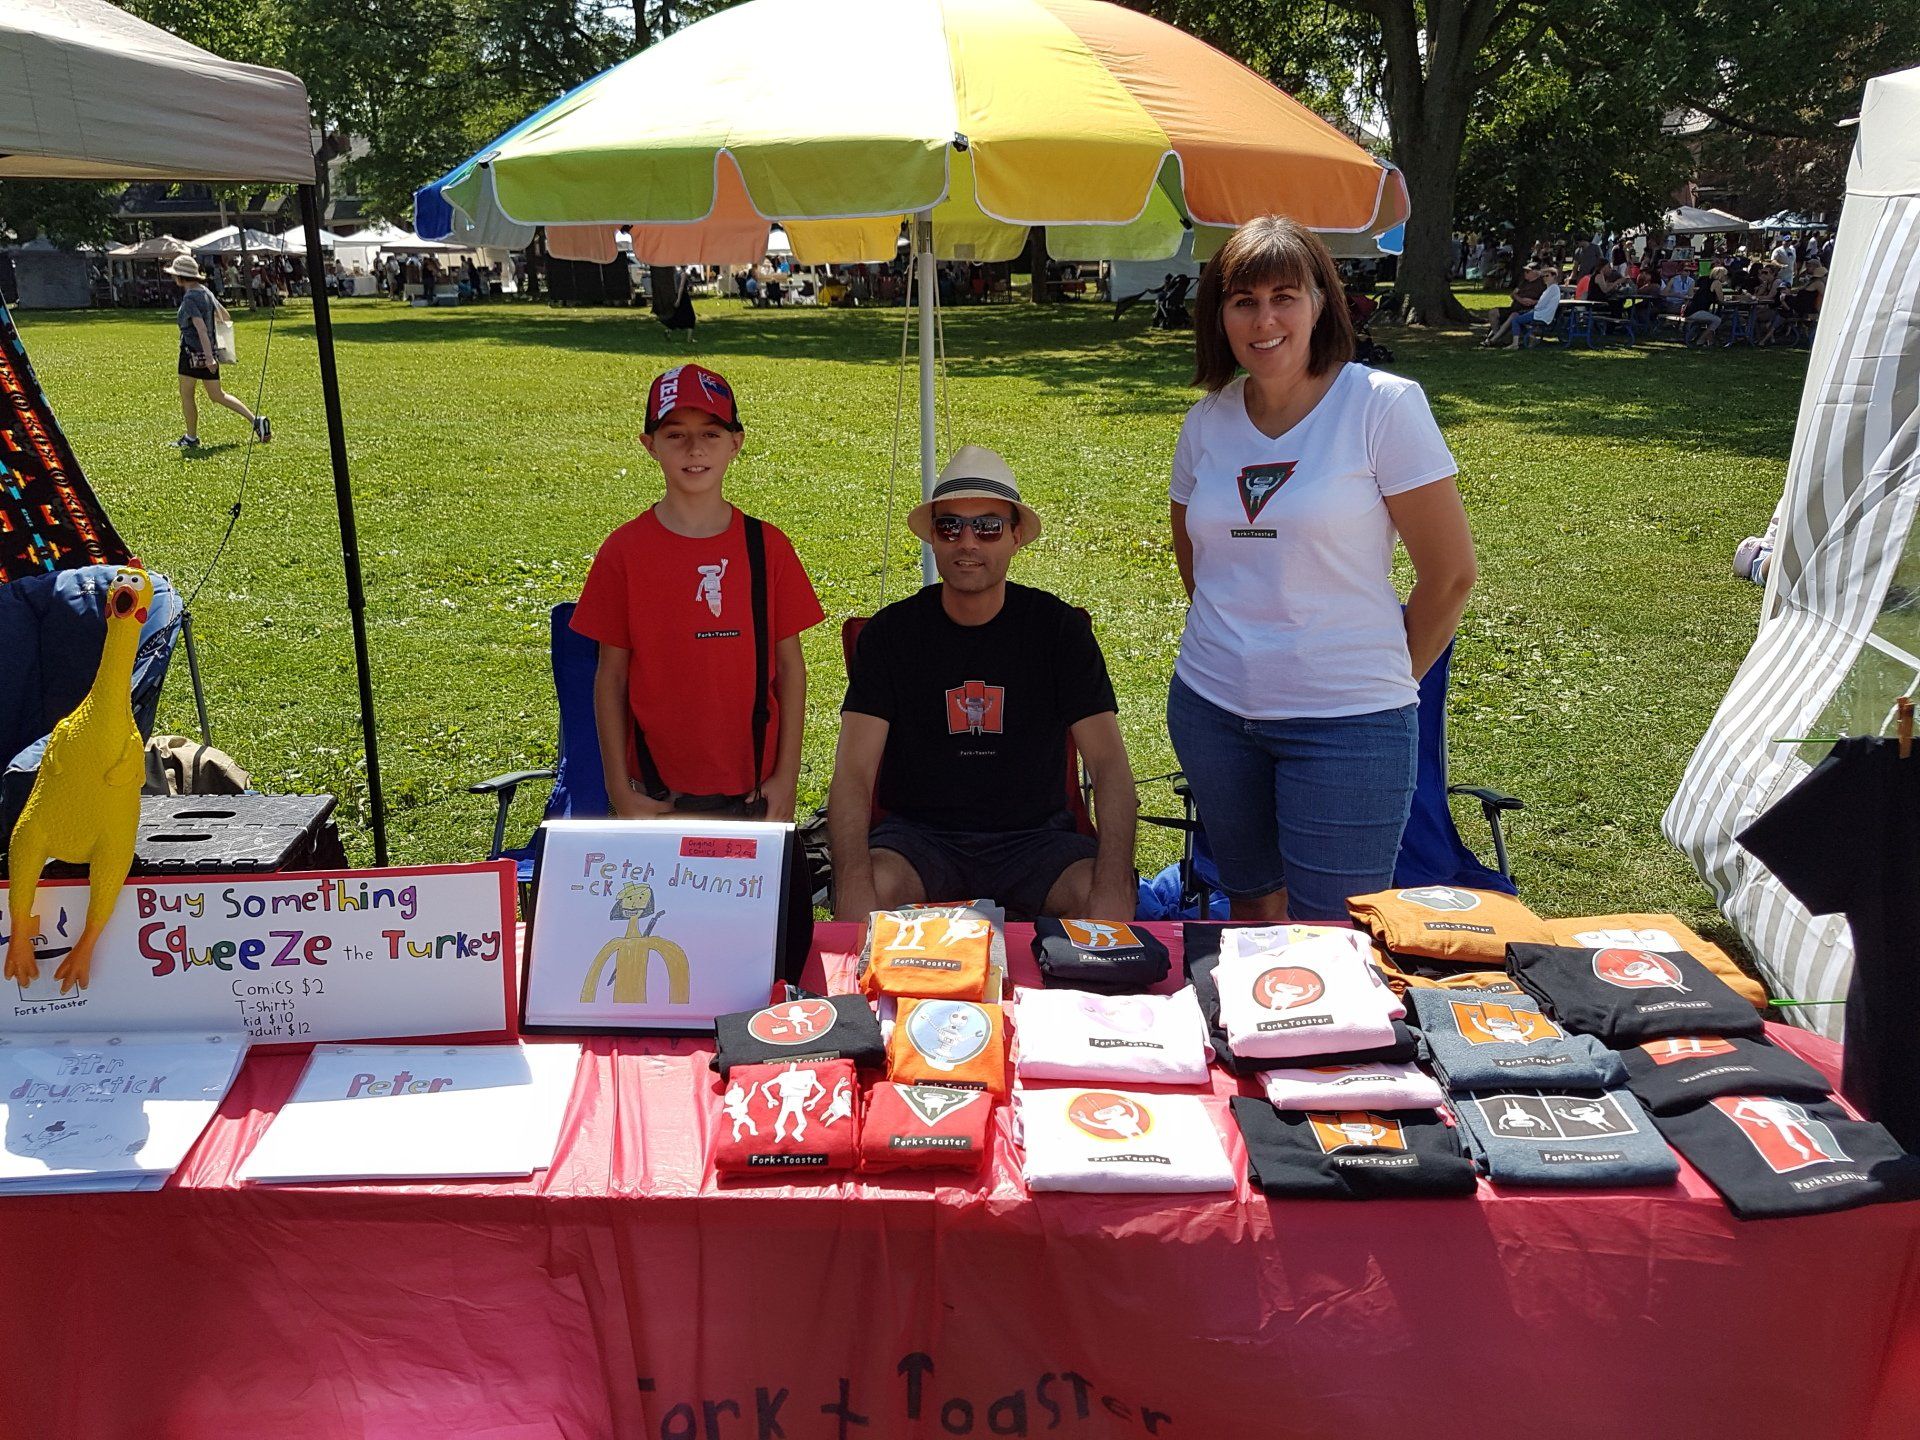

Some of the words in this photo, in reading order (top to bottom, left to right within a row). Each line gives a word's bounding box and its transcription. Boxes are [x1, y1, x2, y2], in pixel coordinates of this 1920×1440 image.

[136, 887, 205, 919] Buy
[221, 878, 418, 920] Something
[342, 944, 374, 962] the
[381, 929, 501, 962] Turkey
[302, 977, 325, 997] $2
[242, 1016, 262, 1027] kid
[1259, 1016, 1330, 1031] Fork+Toaster
[345, 1070, 453, 1098] Peter
[893, 1137, 968, 1147] Fork+Toaster
[751, 1155, 824, 1165] Fork+Toaster
[1338, 1158, 1415, 1167] Fork+Toaster
